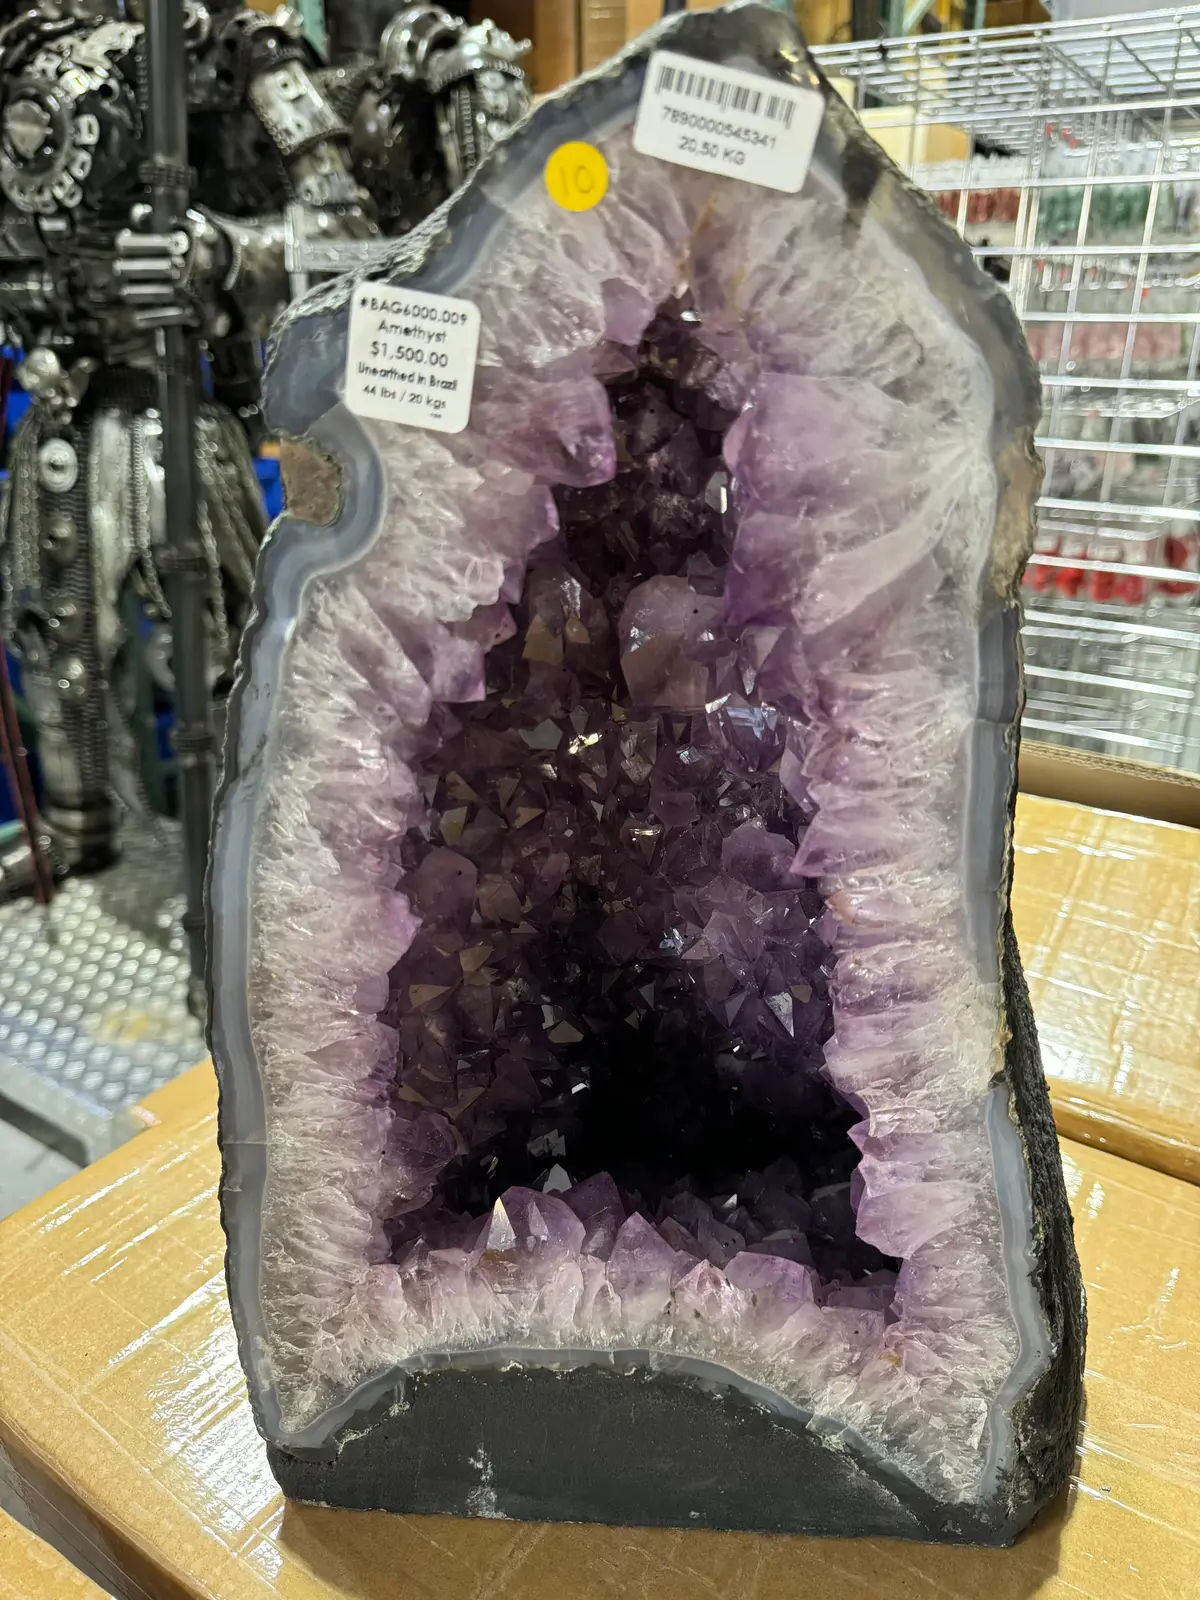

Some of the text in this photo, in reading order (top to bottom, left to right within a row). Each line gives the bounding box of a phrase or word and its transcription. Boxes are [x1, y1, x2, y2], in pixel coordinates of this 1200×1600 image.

[723, 148, 746, 165] KG
[559, 165, 595, 197] 10
[378, 319, 447, 344] Amethyst
[370, 340, 448, 367] $1,500.00
[358, 361, 458, 391] Unearthed in Brazil
[363, 384, 377, 396] 44
[380, 386, 397, 399] lbs
[408, 393, 423, 404] 20
[426, 395, 446, 410] kgs
